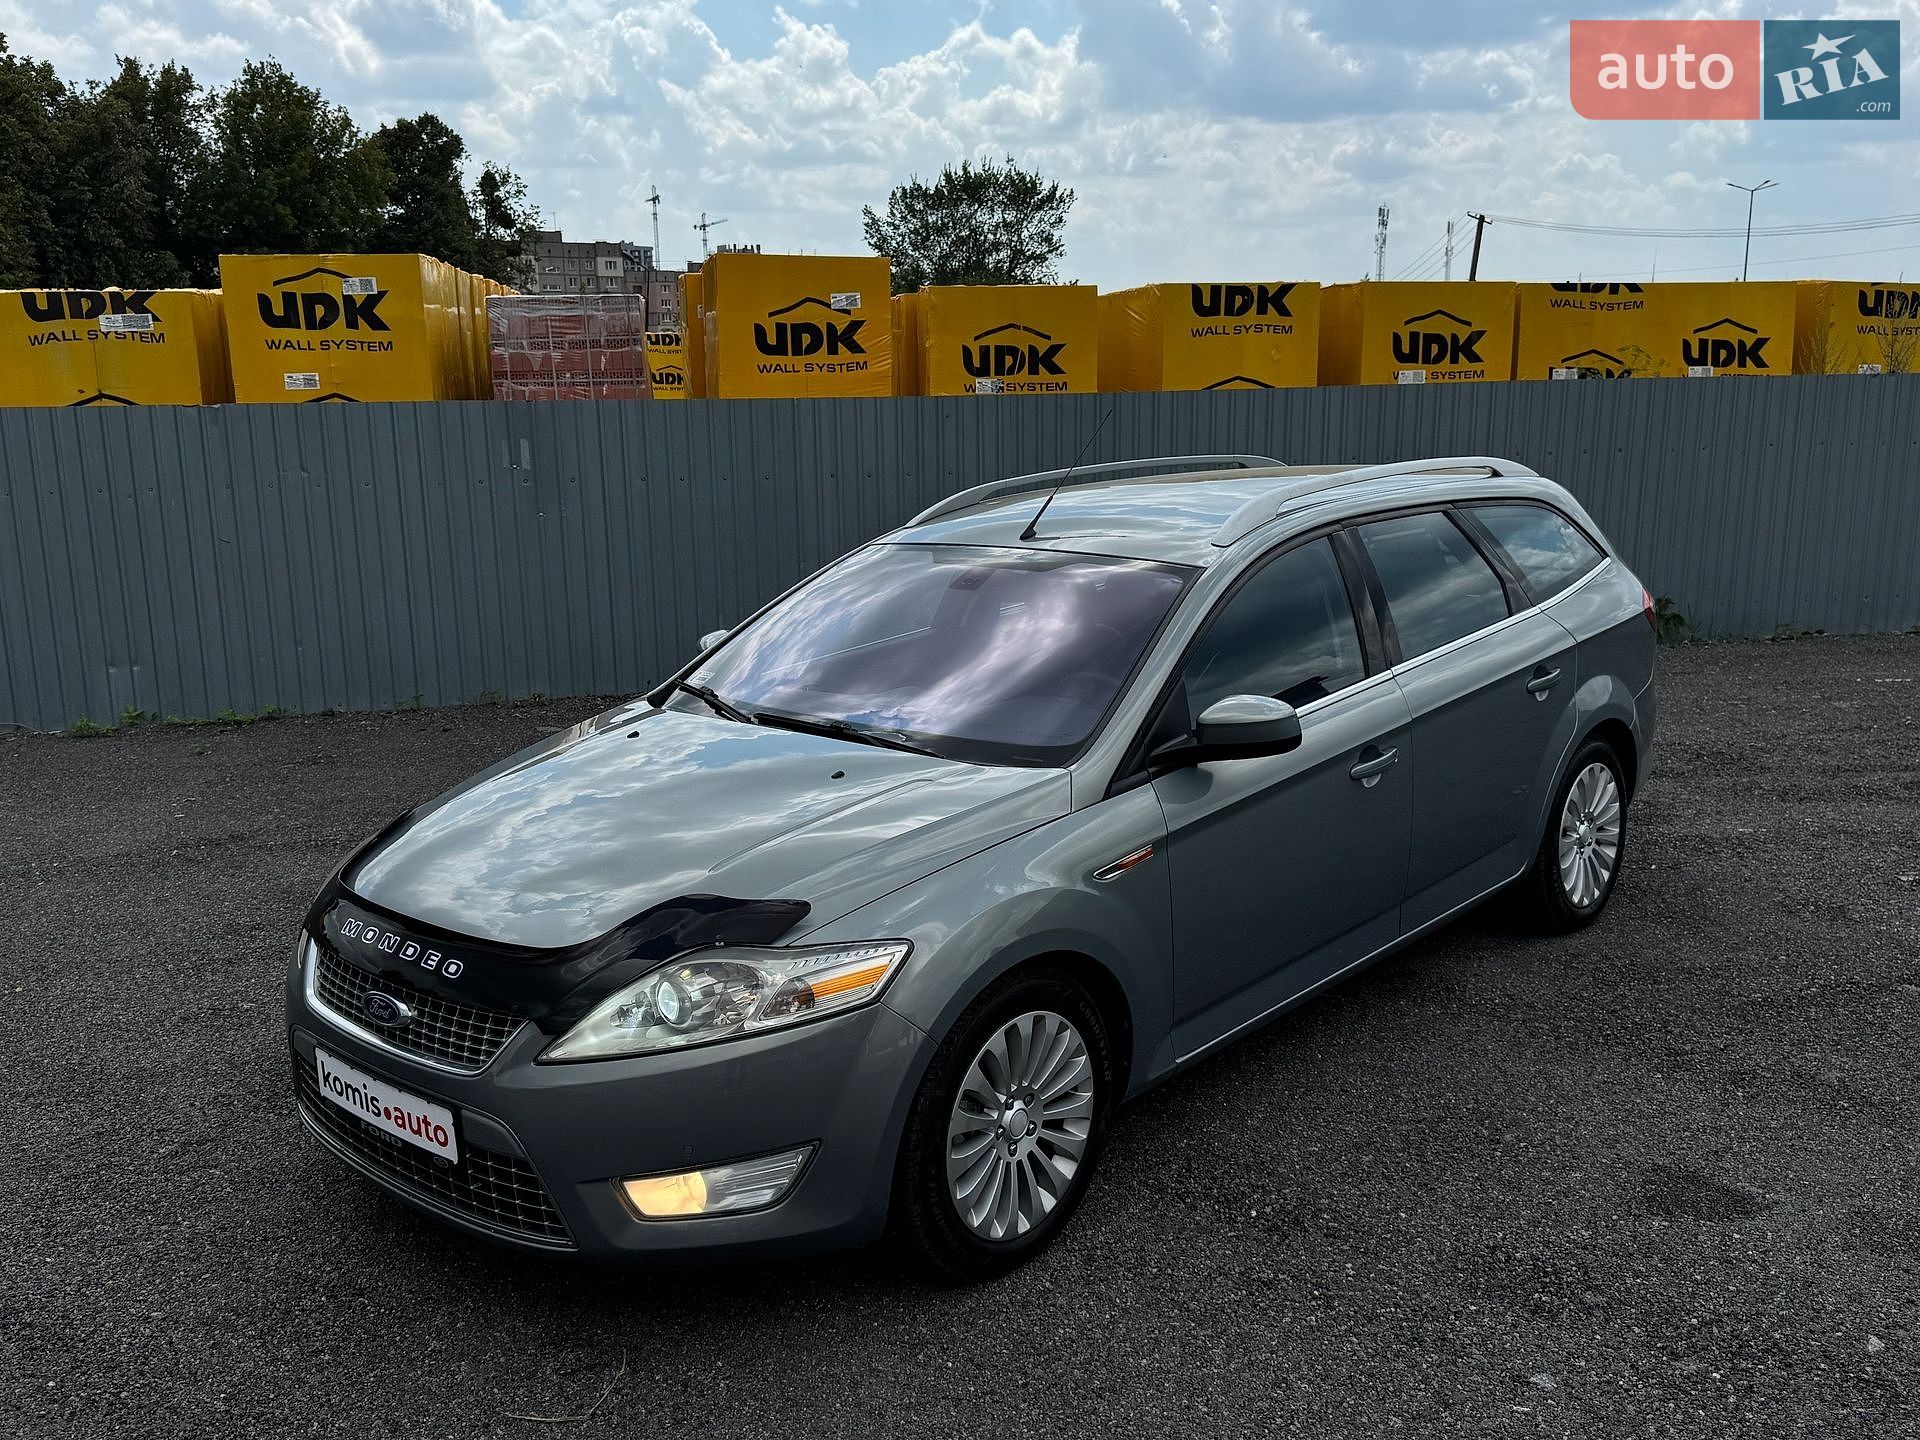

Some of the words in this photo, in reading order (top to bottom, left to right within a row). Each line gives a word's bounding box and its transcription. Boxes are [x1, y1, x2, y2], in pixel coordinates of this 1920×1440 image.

[20, 291, 163, 322] UDK
[257, 290, 391, 331] UDK
[1192, 283, 1298, 317] UDK
[1550, 298, 1586, 309] WALL
[1589, 300, 1644, 312] SYSTEM
[28, 329, 82, 346] WALL
[87, 329, 166, 344] SYSTEM
[265, 339, 316, 351] WALL
[320, 339, 393, 352] SYSTEM
[754, 320, 867, 356] UDK
[1191, 325, 1230, 337] WALL
[1233, 323, 1293, 335] SYSTEM
[962, 343, 1068, 377] UDK
[1393, 330, 1487, 364] UDK
[1682, 337, 1771, 369] UDK
[757, 363, 800, 374] WALL
[804, 361, 868, 373] SYSTEM
[1431, 369, 1485, 380] SYSTEM
[1006, 381, 1068, 392] SYSTEM
[341, 918, 464, 979] MONDEO
